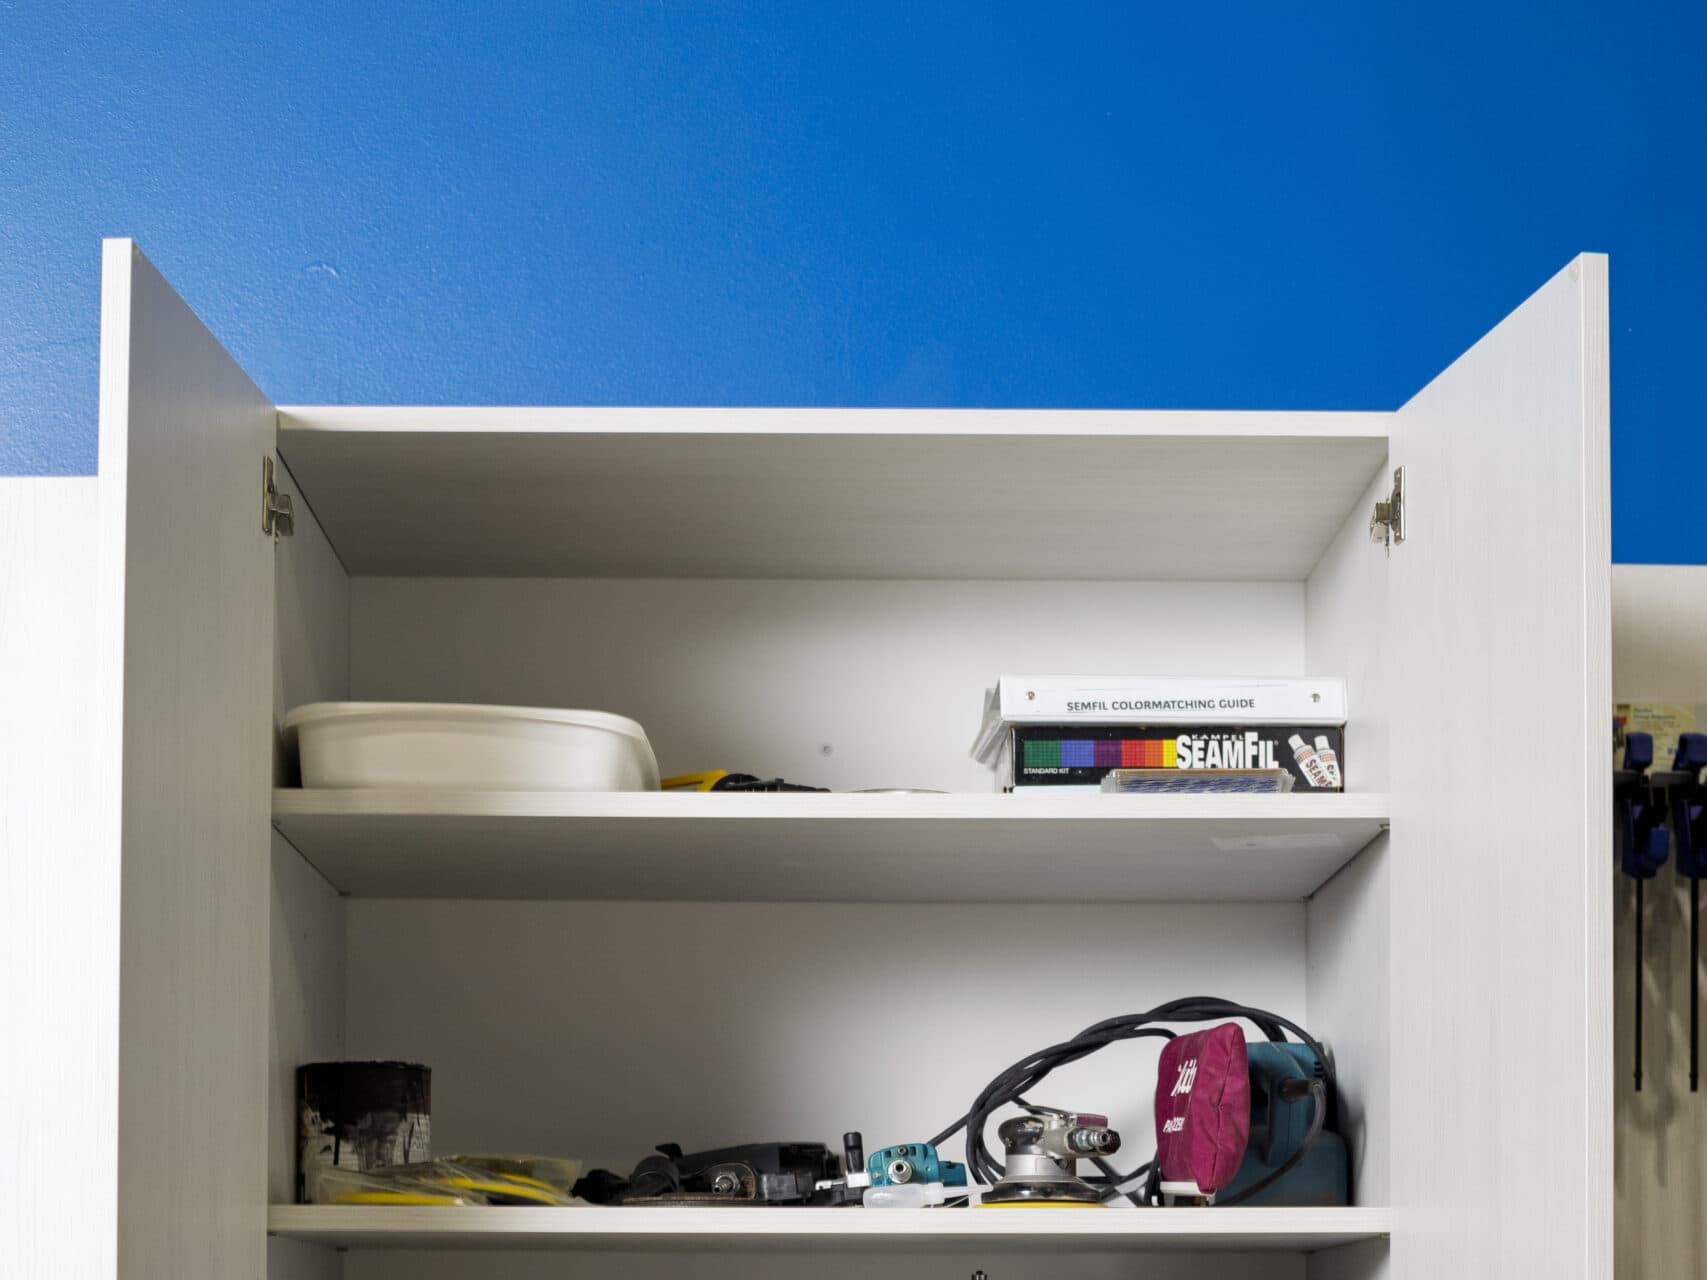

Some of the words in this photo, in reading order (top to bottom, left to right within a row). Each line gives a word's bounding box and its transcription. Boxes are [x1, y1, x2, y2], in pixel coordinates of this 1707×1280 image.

[1067, 701, 1108, 711] SEMFIL
[1112, 700, 1215, 710] COLORMATCHING
[1219, 699, 1255, 708] GUIDE
[1176, 732, 1279, 769] SEAMFIL
